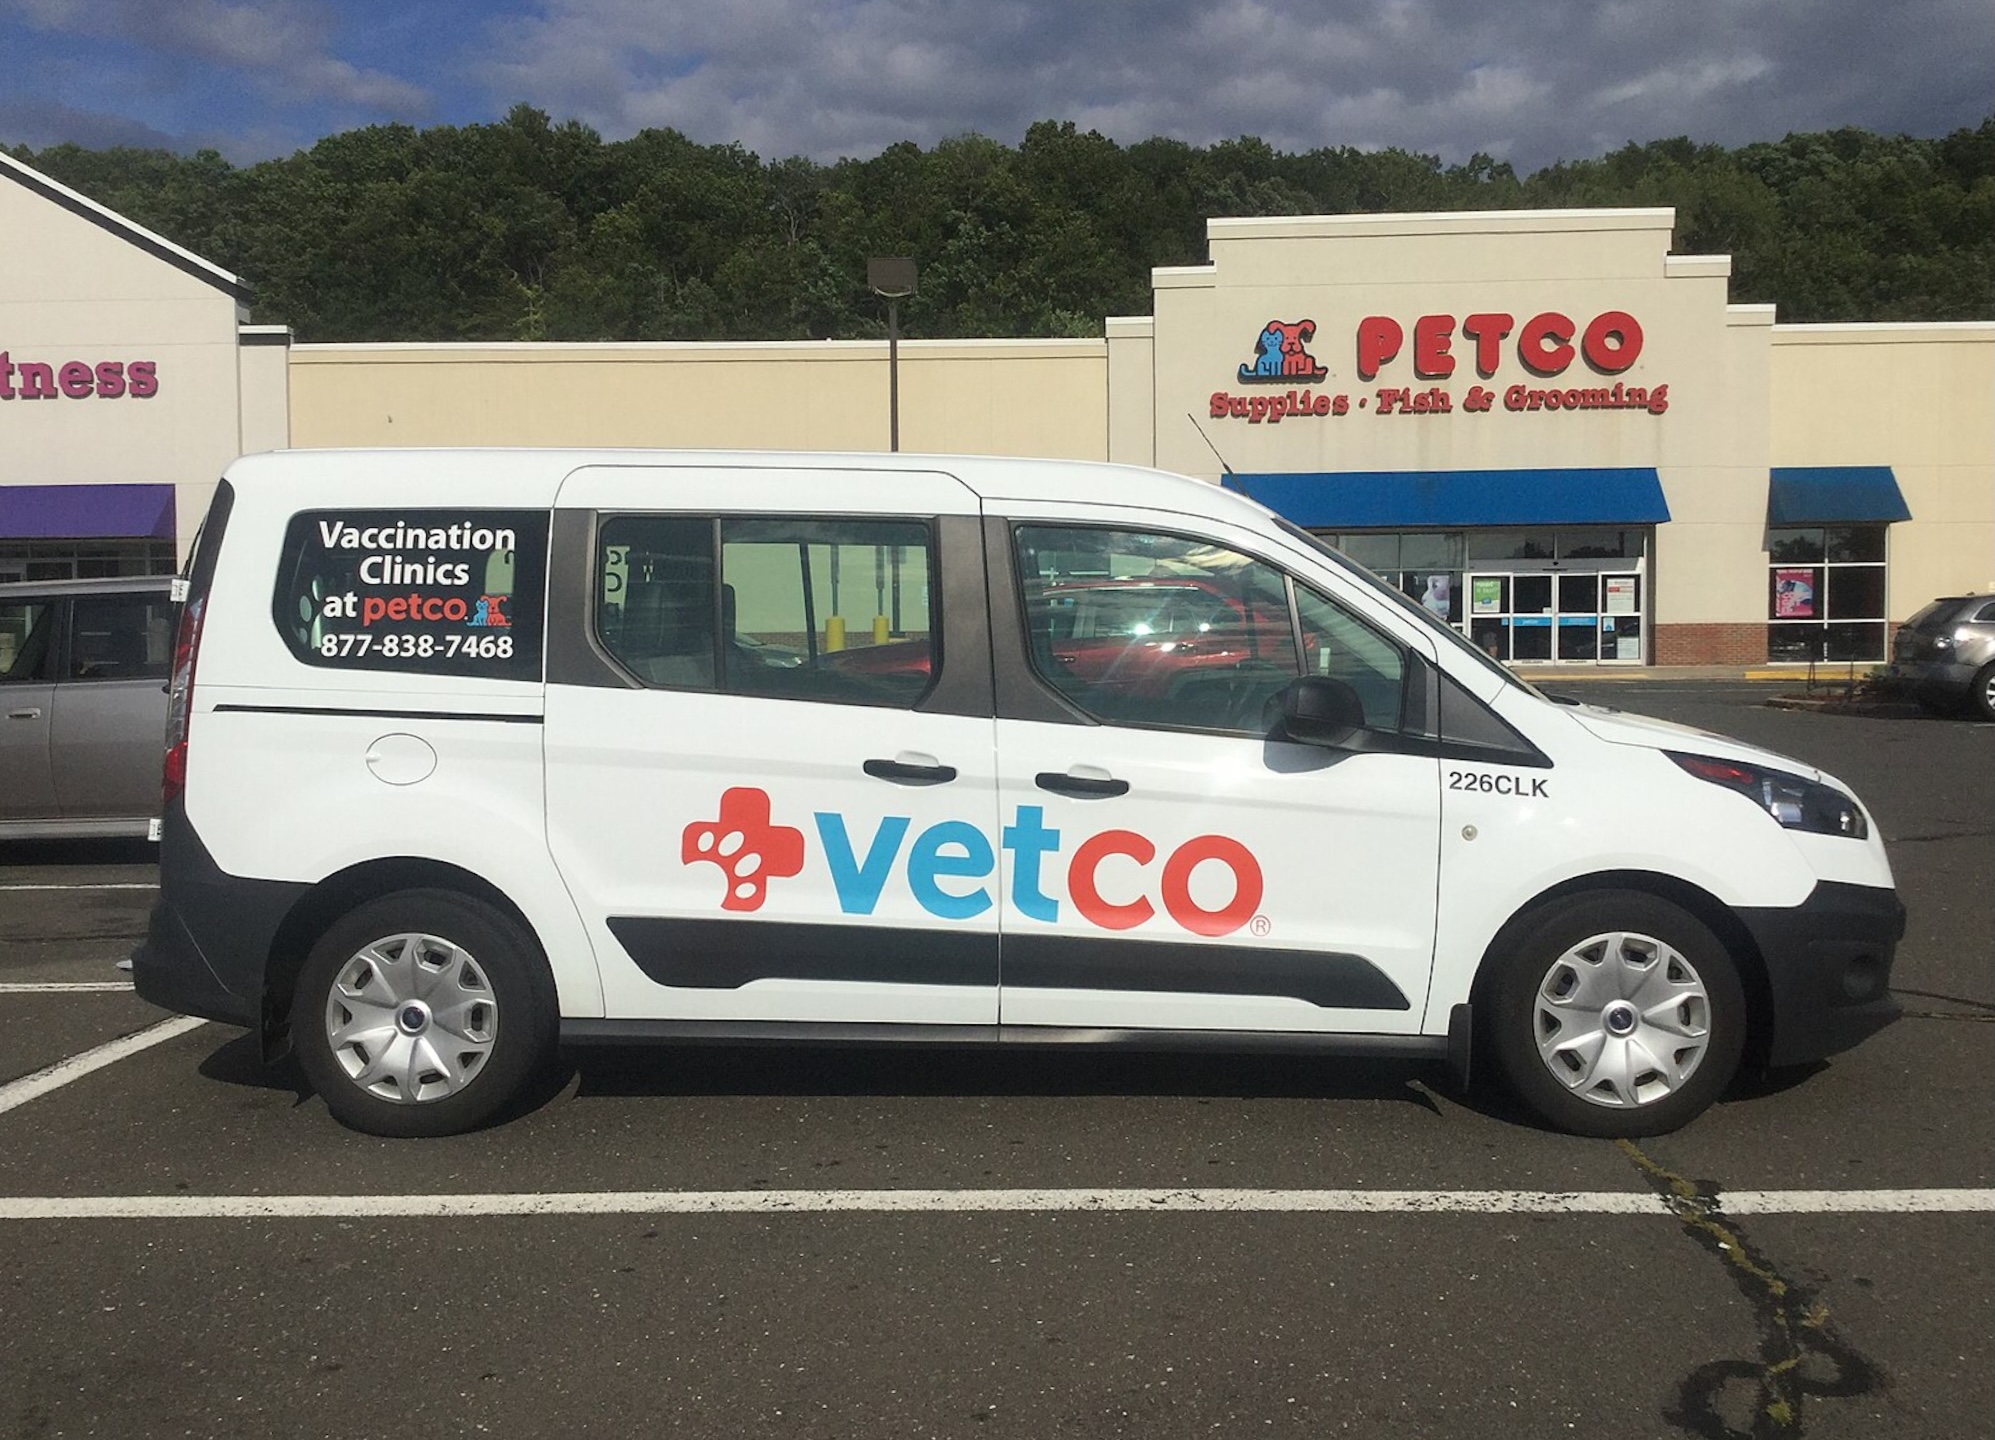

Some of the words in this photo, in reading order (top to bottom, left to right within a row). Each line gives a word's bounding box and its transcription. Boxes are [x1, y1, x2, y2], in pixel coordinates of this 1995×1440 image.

[1356, 311, 1643, 381] PETCO
[1210, 390, 1349, 424] Supplies
[1375, 387, 1452, 415] Fish
[1463, 386, 1494, 412] &
[1504, 383, 1668, 415] Grooming
[319, 521, 515, 550] Vaccination
[359, 555, 470, 585] Clinics
[322, 592, 358, 618] at
[320, 634, 514, 659] 877-838-7468
[1449, 771, 1549, 798] 226CLK
[813, 805, 1264, 936] vetco
